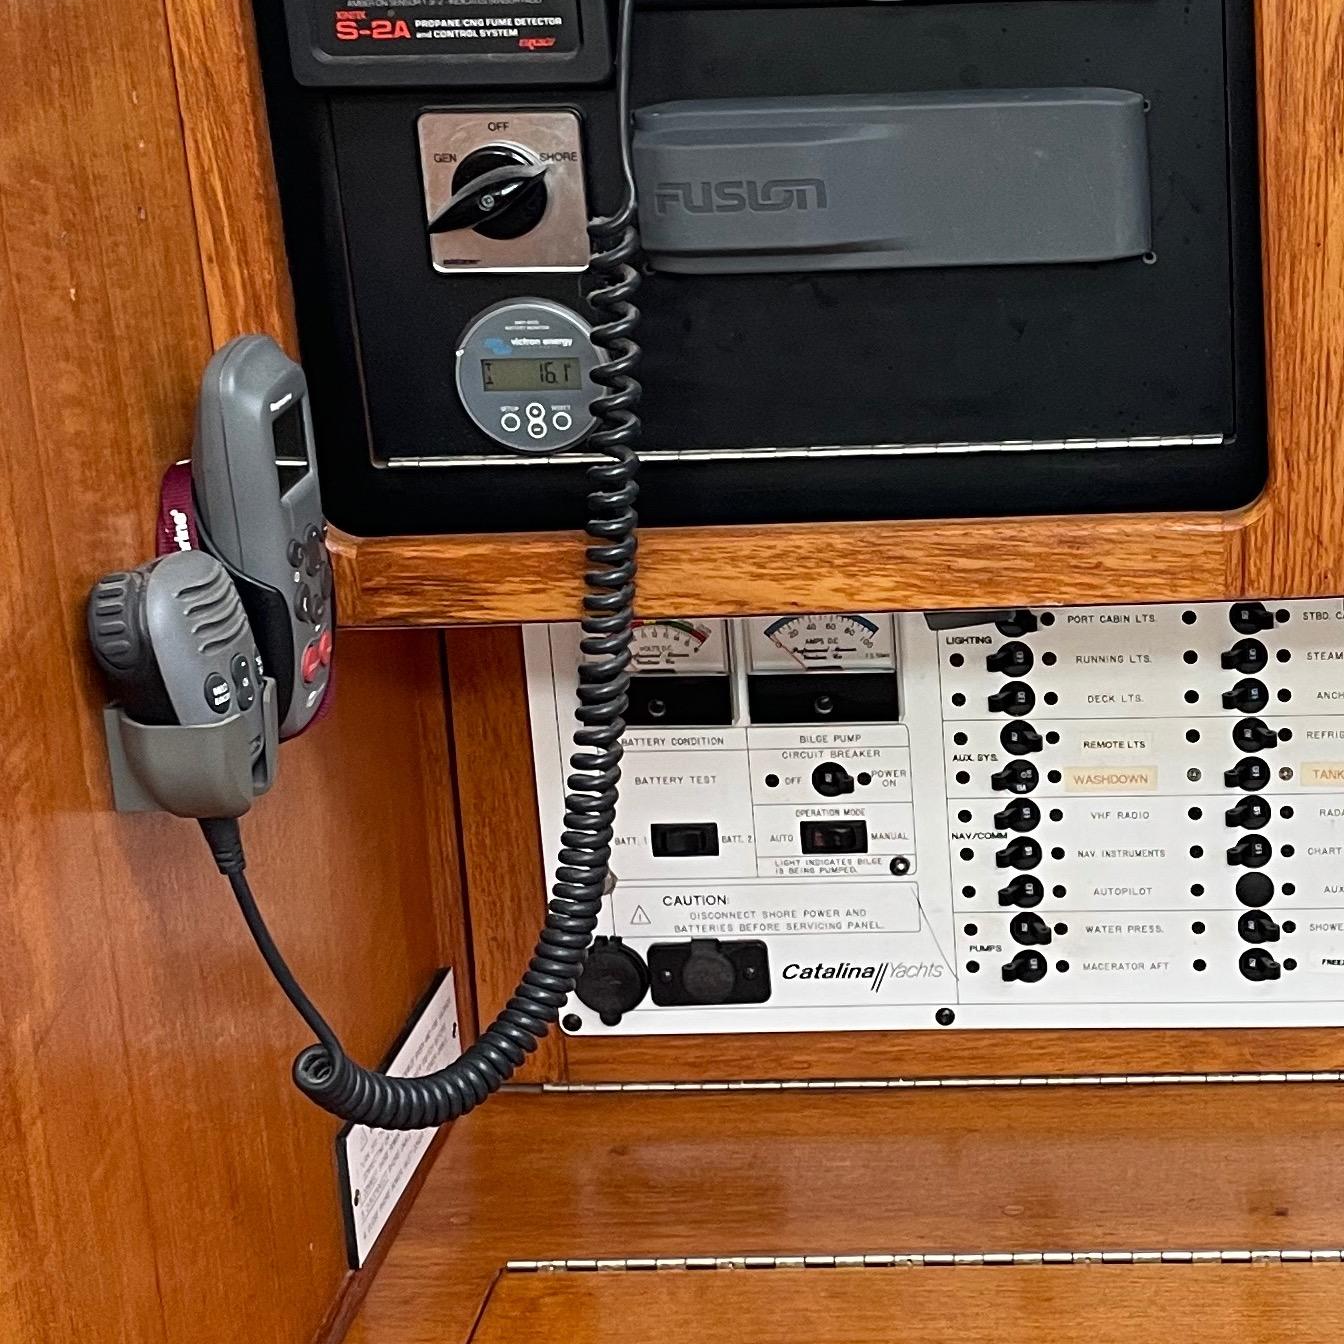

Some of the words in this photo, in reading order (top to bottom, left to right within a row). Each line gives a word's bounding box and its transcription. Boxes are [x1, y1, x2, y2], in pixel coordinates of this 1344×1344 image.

[514, 17, 563, 26] DETECTOR
[336, 20, 411, 40] S-2A
[434, 30, 478, 38] CONTROL
[479, 29, 518, 37] SYSTEM
[487, 122, 510, 132] OFF
[434, 153, 457, 163] GEN
[539, 152, 578, 162] SHORE
[655, 178, 827, 215] FUSION
[1067, 616, 1095, 624] PORT
[1100, 615, 1130, 623] CABIN
[946, 636, 992, 645] LIGHTING
[1076, 655, 1124, 664] RUNNING
[1129, 655, 1153, 663] LTS.
[1088, 695, 1115, 703] DECK
[1121, 694, 1144, 703] LTS.
[621, 738, 666, 746] BATTERY
[671, 737, 724, 746] CONDITION
[800, 735, 828, 744] BILGE
[1083, 741, 1124, 749] REMOTE
[782, 751, 824, 759] CIRCUIT
[830, 750, 881, 758] BREAKER
[1312, 769, 1344, 779] TANK
[635, 777, 684, 785] BATTERY
[690, 776, 717, 784] TEST
[785, 777, 802, 785] OFF
[1073, 775, 1148, 785] WASHDOWN
[795, 809, 840, 817] OPERATION
[843, 808, 866, 816] MODE
[1117, 811, 1150, 819] RADIO
[769, 834, 794, 843] AUTO
[871, 832, 910, 841] MANUAL
[952, 832, 1008, 840] NAV/COMM
[1101, 849, 1166, 857] INSTRUMENTS
[1307, 847, 1342, 855] CHART
[1093, 888, 1152, 896] AUTOPILOT
[689, 911, 755, 921] DISCONNECT
[762, 910, 797, 919] SHORE
[803, 909, 840, 918] POWER
[845, 908, 868, 917] AND
[674, 923, 733, 933] BATTERIES
[739, 922, 782, 932] BEFORE
[786, 921, 842, 931] SERVICING
[1086, 925, 1122, 933] WATER
[1083, 962, 1145, 970] MACERATOR
[1150, 962, 1169, 970] AFT
[782, 963, 874, 980] Catalina
[888, 963, 945, 979] Yachts
